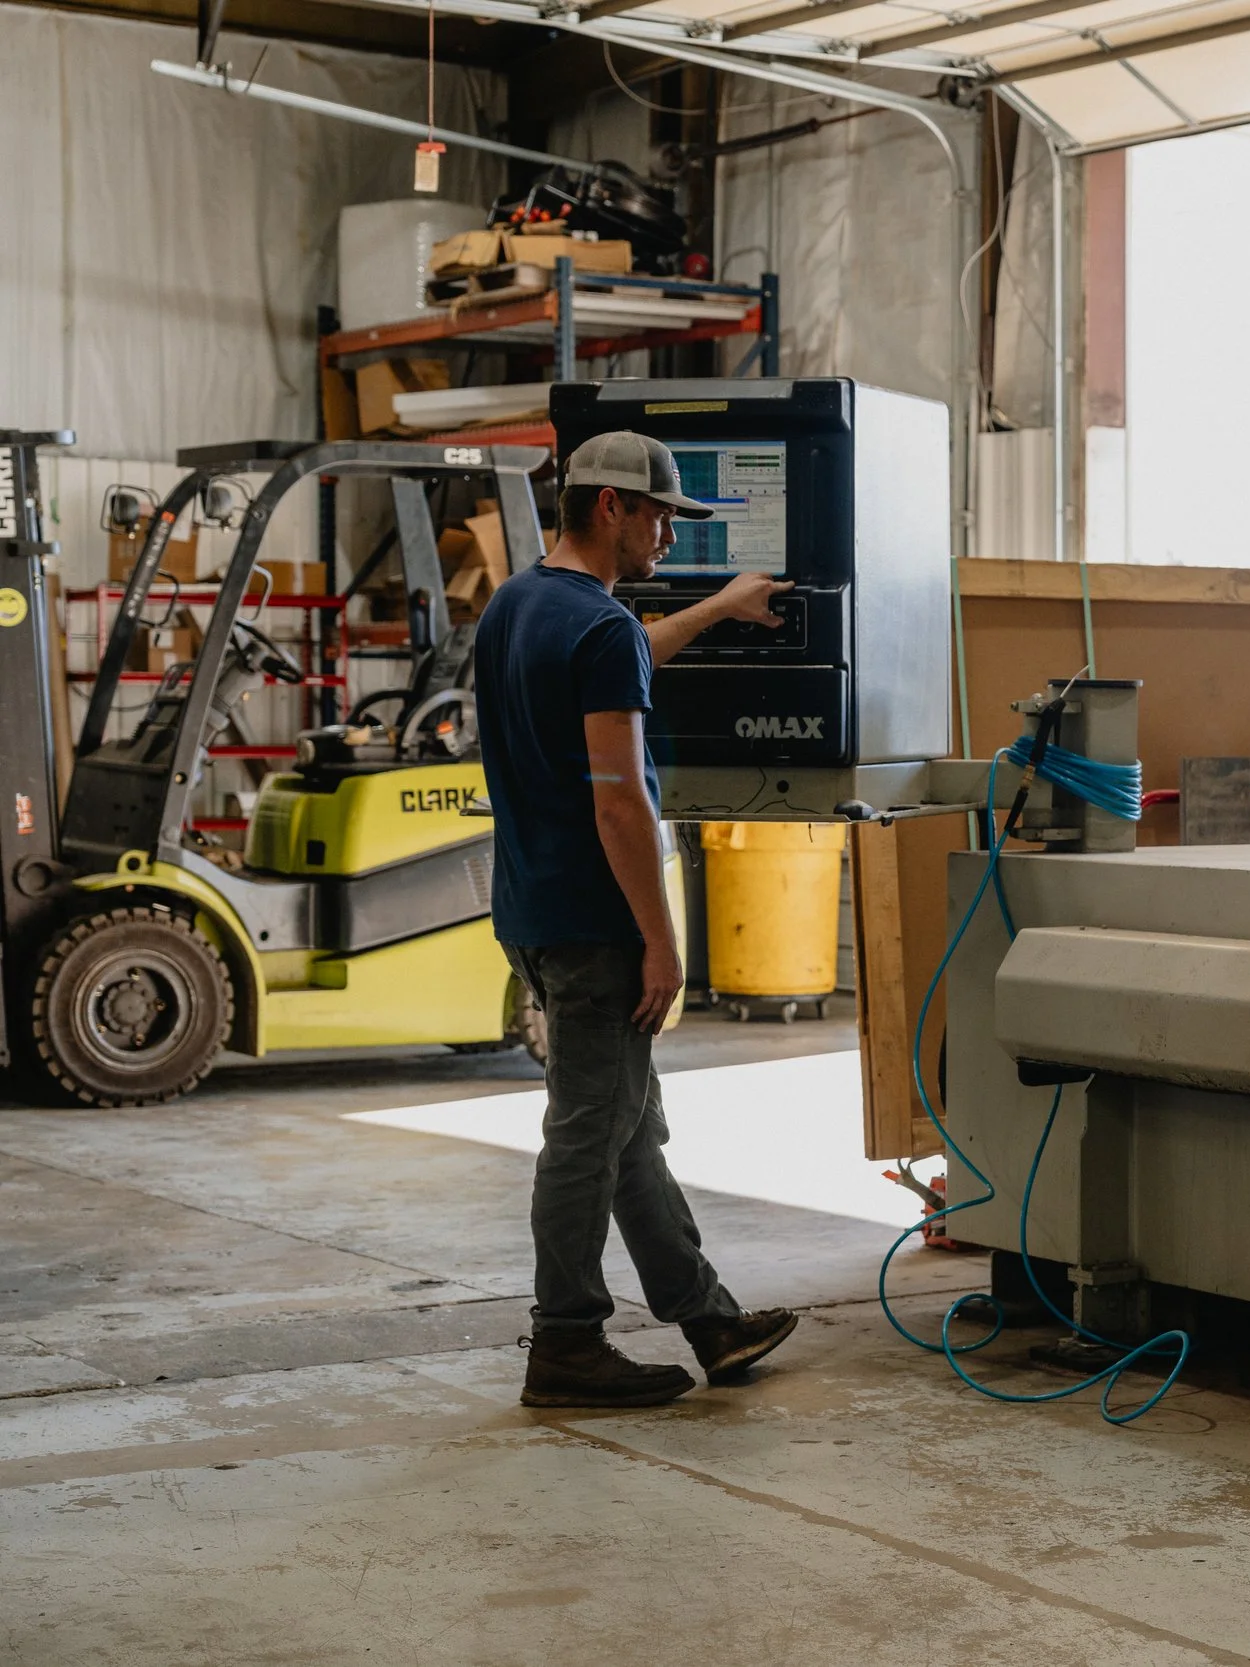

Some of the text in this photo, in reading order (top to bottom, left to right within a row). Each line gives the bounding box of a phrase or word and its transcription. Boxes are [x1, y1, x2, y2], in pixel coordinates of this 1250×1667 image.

[444, 447, 482, 465] C25
[735, 716, 824, 739] OMAX
[401, 787, 476, 812] CLARK
